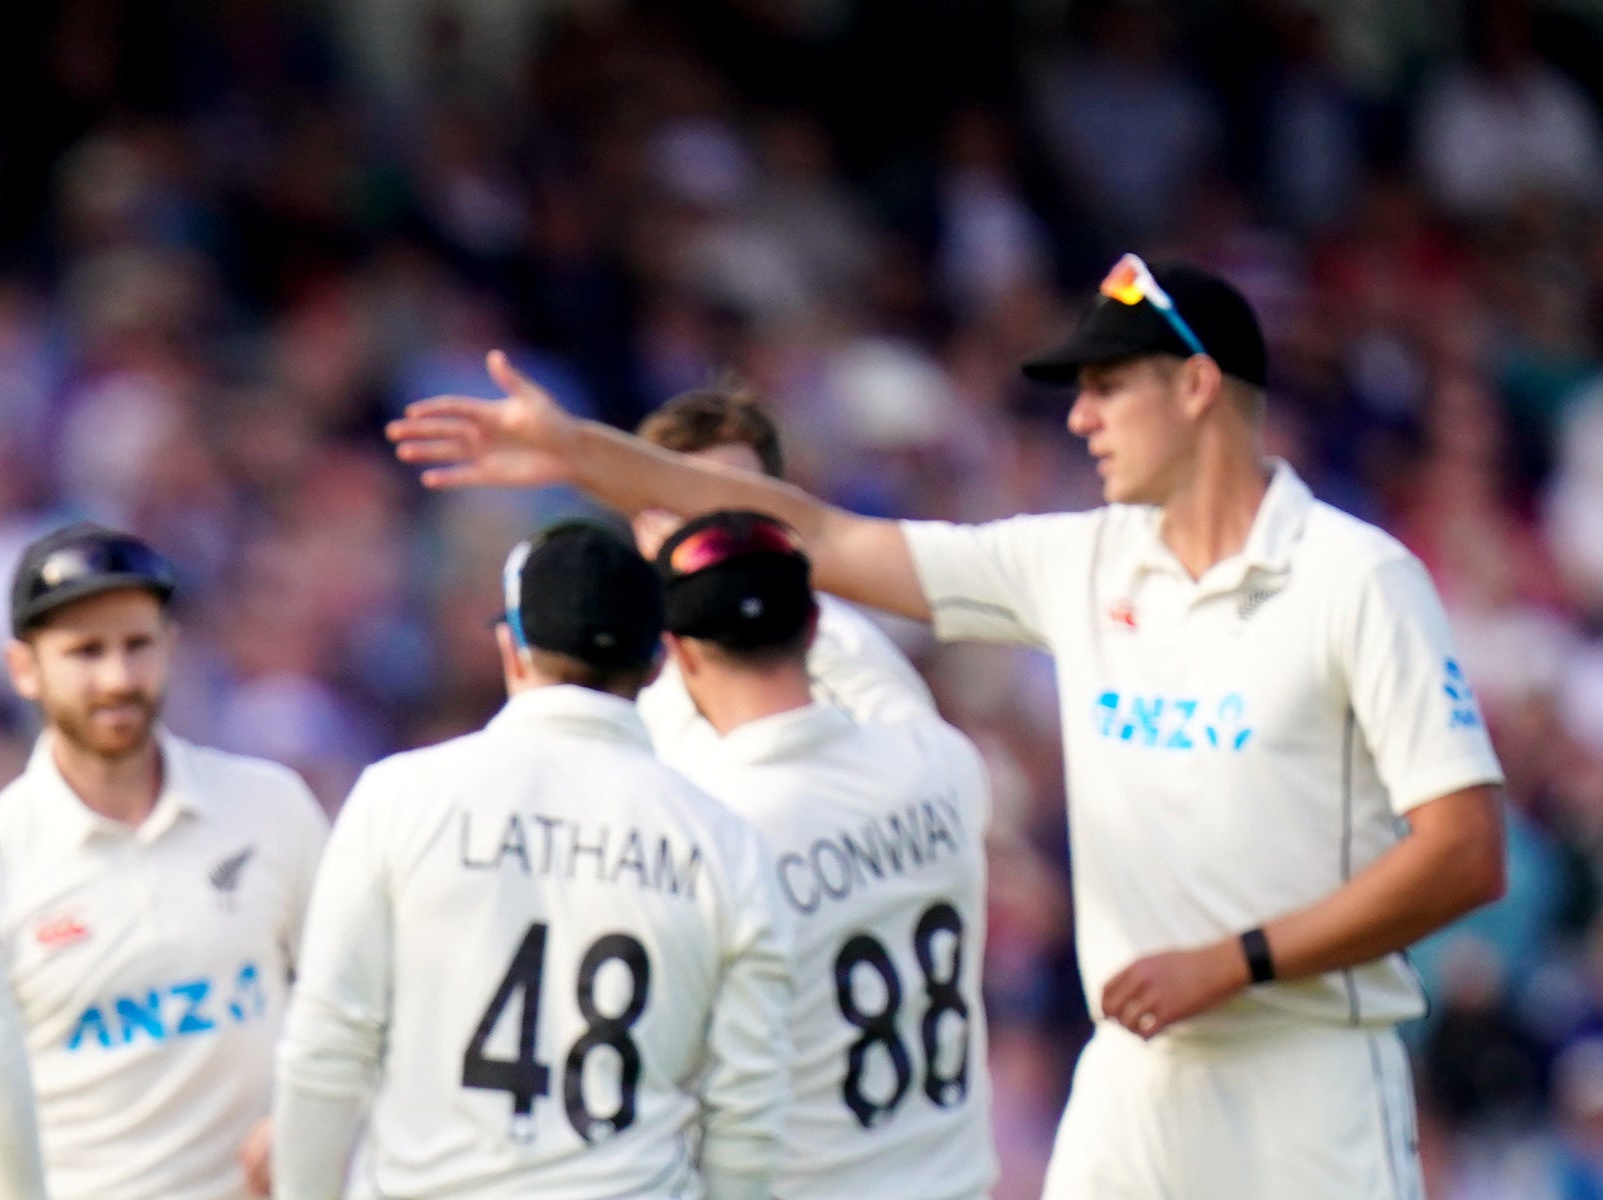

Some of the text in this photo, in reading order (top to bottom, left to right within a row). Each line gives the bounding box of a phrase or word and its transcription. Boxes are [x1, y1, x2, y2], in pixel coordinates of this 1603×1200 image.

[461, 811, 702, 900] LATHAM
[777, 786, 967, 916] CONWAY
[67, 981, 216, 1050] ANZ
[461, 917, 651, 1146] 48
[834, 898, 970, 1130] 88
